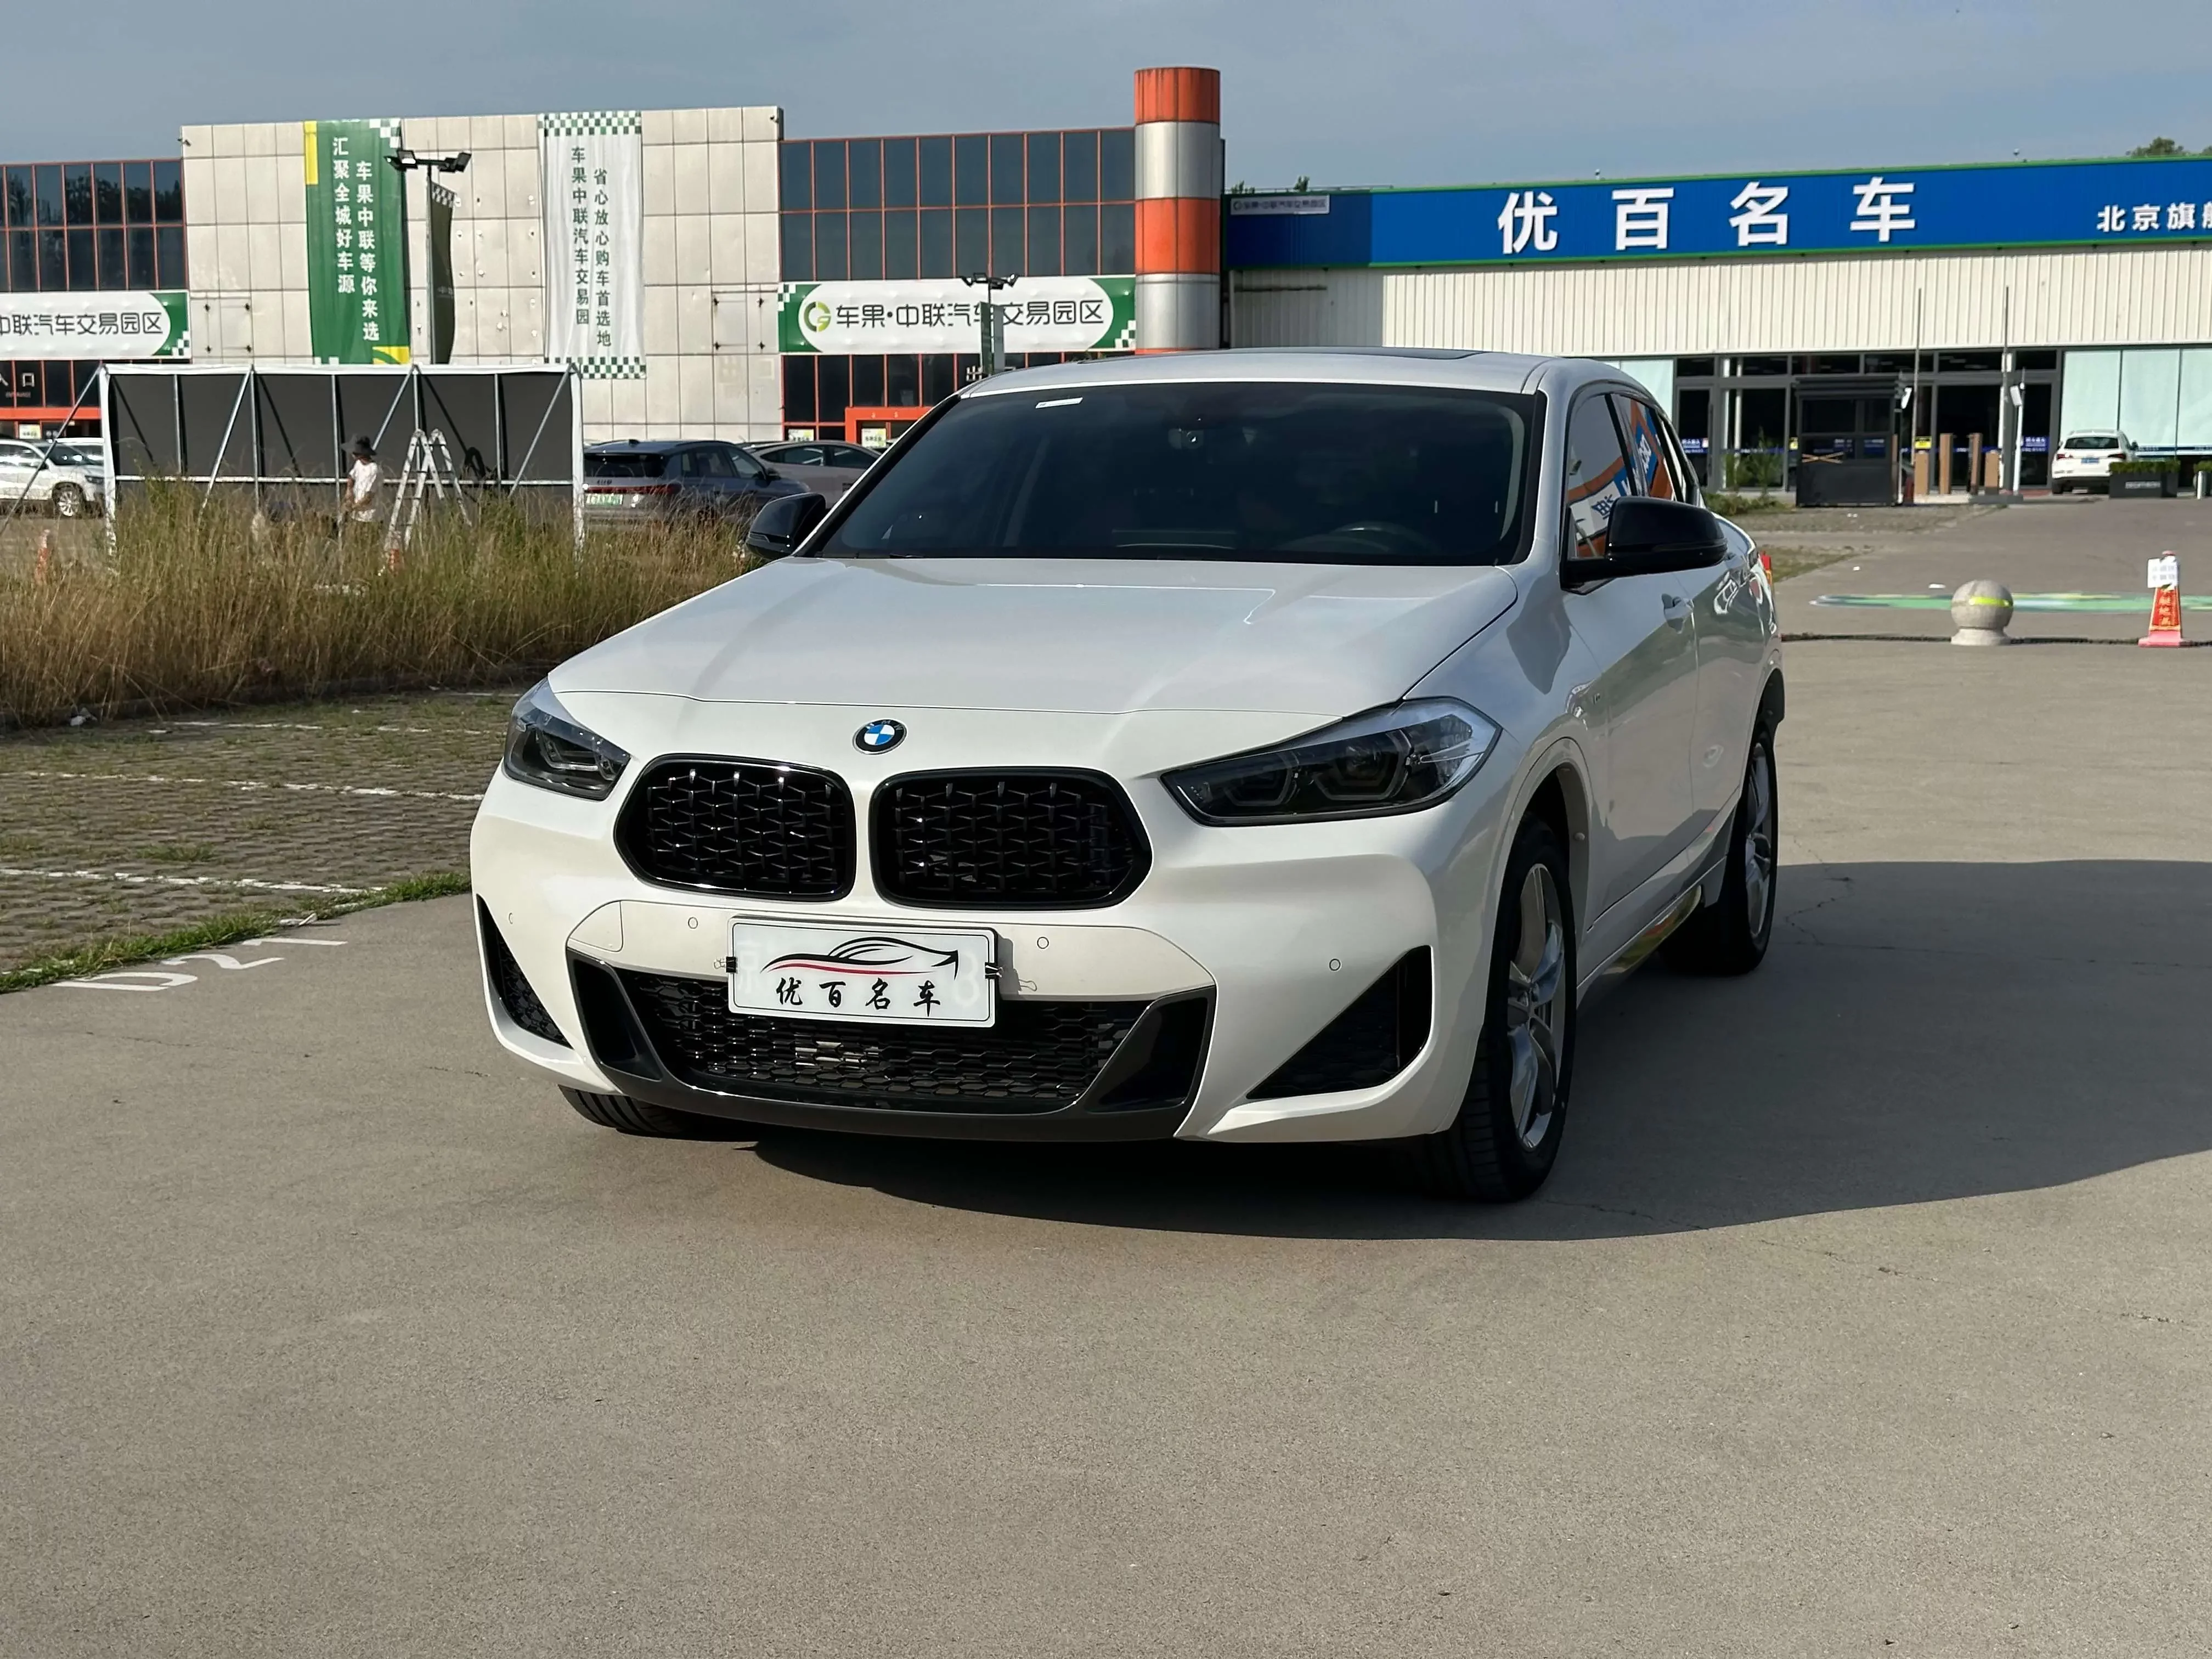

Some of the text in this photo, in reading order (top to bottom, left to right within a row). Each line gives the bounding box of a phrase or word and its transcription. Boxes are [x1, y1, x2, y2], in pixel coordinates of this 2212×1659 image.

[333, 137, 356, 294] 汇聚全城好车源
[356, 160, 380, 341] 车果中联等你来选
[571, 146, 589, 325] 车果中联汽车交易园
[594, 167, 612, 347] 省心放心购车首选地
[1497, 176, 1915, 254] 优百名车
[776, 977, 941, 1017] 优百名车
